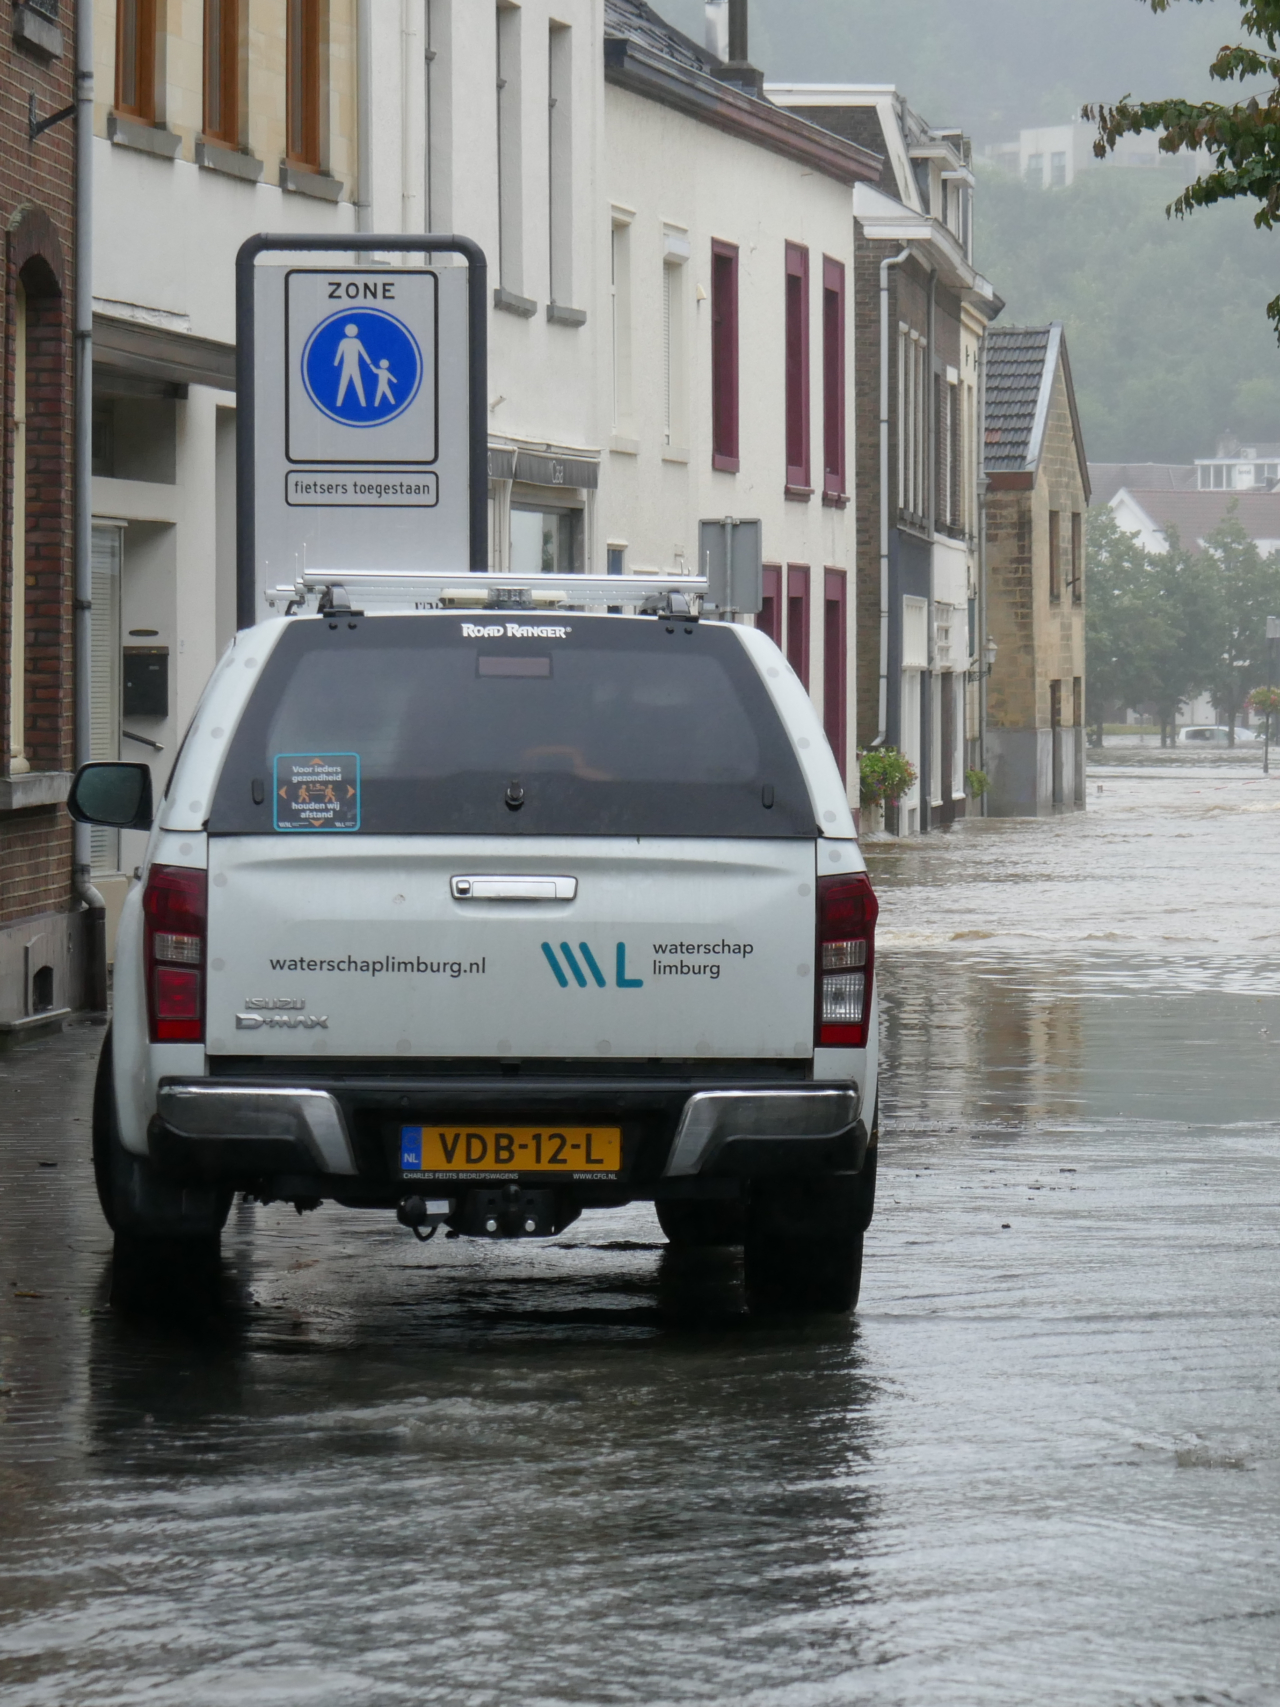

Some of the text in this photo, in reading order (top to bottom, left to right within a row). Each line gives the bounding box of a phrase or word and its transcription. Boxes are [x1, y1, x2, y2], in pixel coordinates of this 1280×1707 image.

[328, 282, 396, 300] ZONE
[294, 481, 430, 498] fietsers toegestaan
[460, 623, 504, 638] ROAD
[292, 765, 341, 773] Voor ieders
[291, 774, 342, 783] gezondheid
[291, 802, 340, 811] houden wij
[300, 811, 333, 819] afstand
[652, 939, 754, 959] waterschap
[269, 955, 486, 978] waterschaplimburg.nl
[652, 960, 721, 980] limburg
[245, 997, 306, 1010] ISUZU
[438, 1132, 604, 1165] VDB-12-L
[404, 1153, 419, 1163] NL
[403, 1172, 434, 1180] CHARLES
[458, 1172, 519, 1180] BEDRIJFSWAGENS
